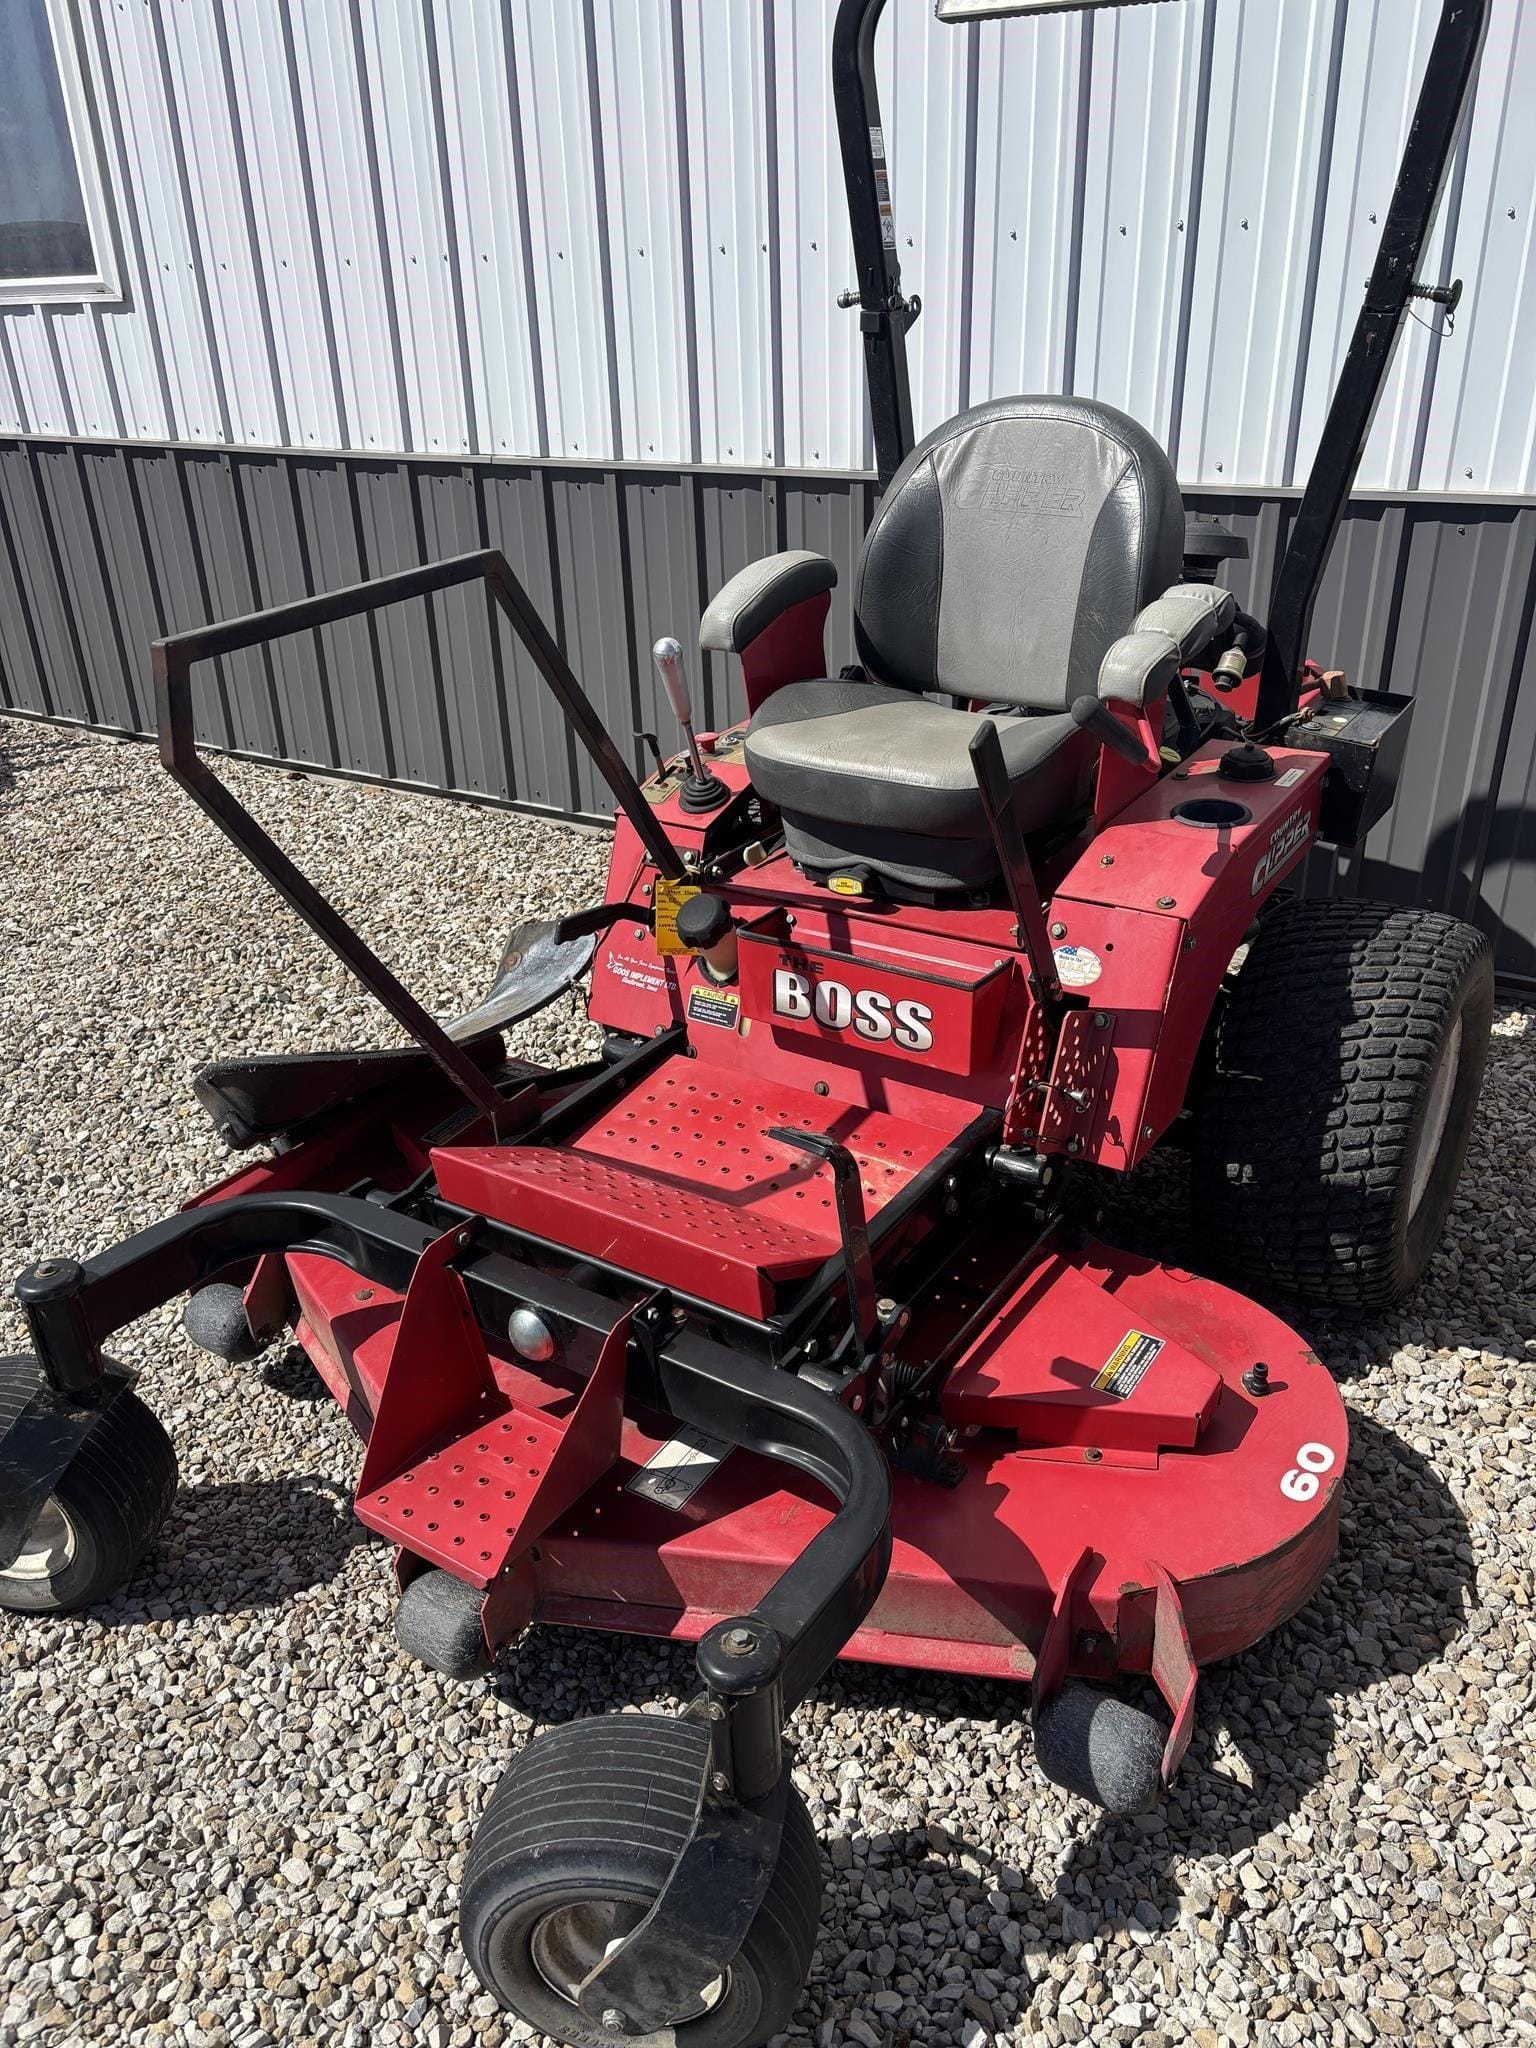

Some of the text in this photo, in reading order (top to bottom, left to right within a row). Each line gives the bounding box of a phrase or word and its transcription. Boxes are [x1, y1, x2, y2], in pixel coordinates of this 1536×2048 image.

[991, 467, 1065, 485] COUNTRY
[1269, 805, 1302, 846] COUNTRY
[1251, 809, 1312, 898] CLIPPER
[612, 966, 631, 977] GOOS
[630, 970, 665, 987] IMPLEMENT
[779, 953, 824, 975] THE
[772, 968, 934, 1053] BOSS
[1108, 1344, 1132, 1372] WARNING
[1280, 1442, 1335, 1502] 60
